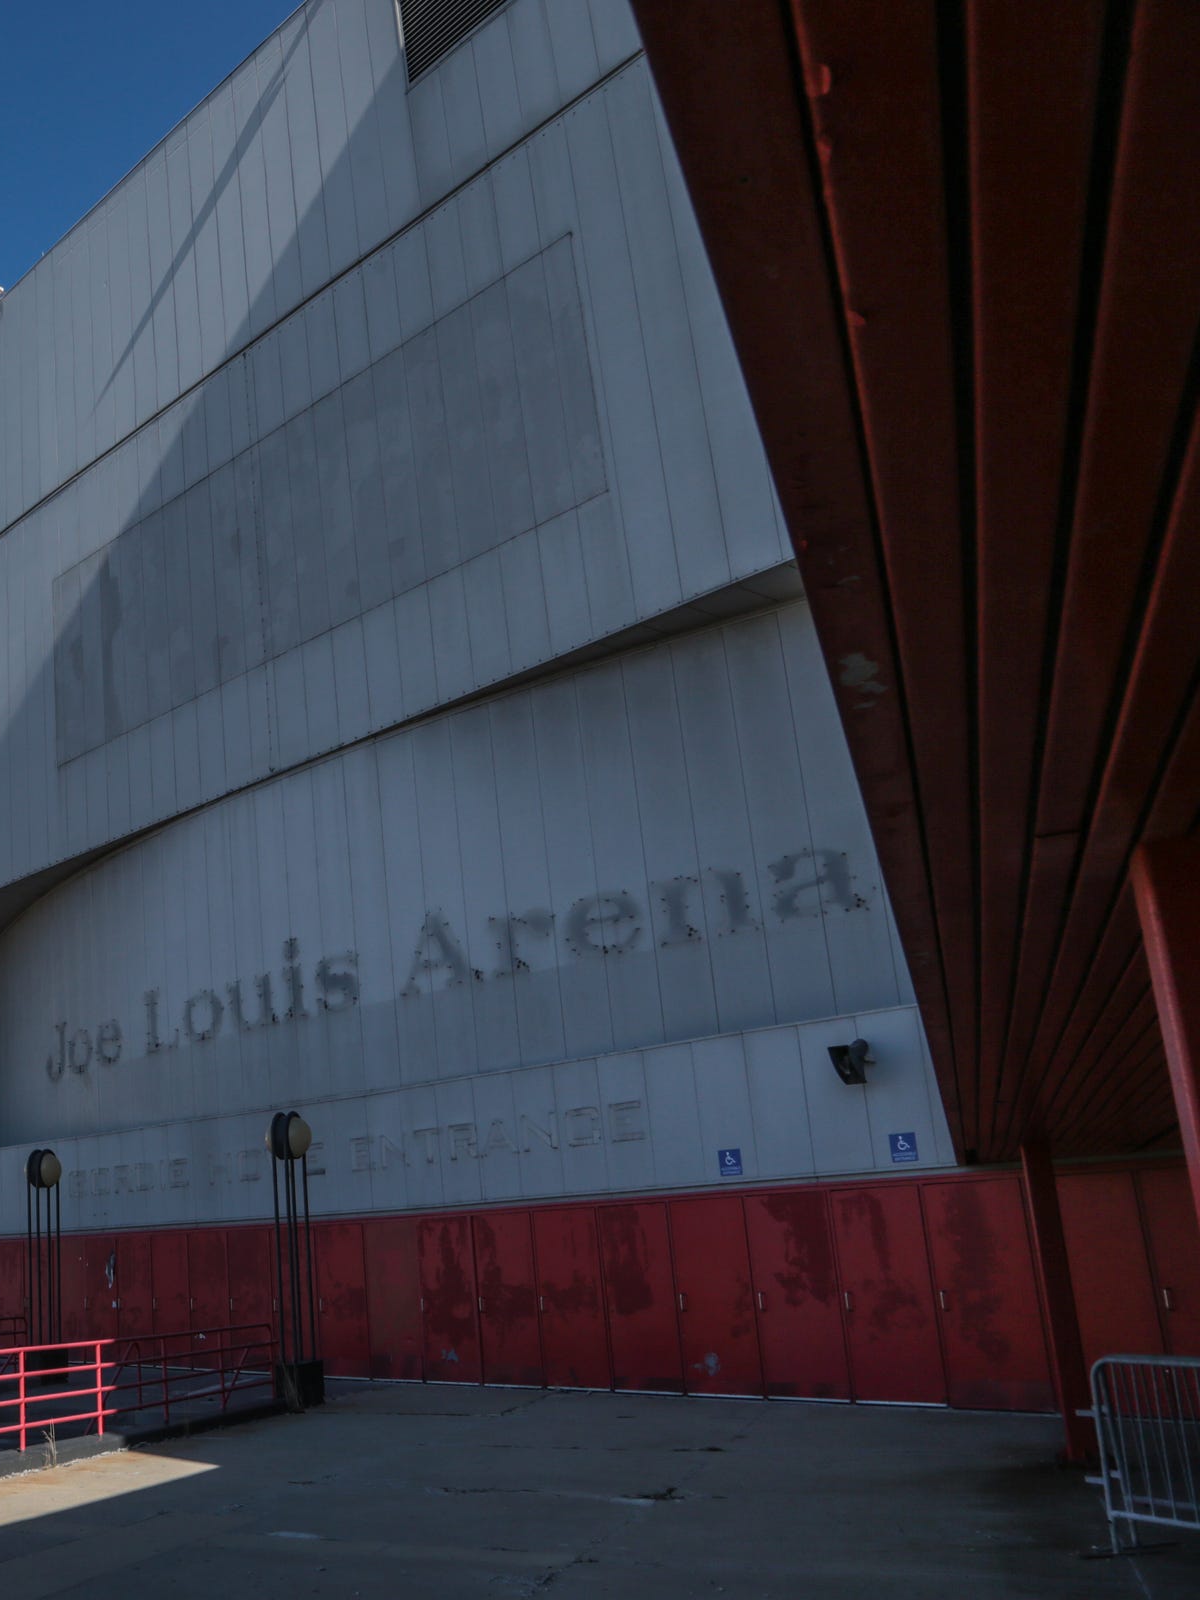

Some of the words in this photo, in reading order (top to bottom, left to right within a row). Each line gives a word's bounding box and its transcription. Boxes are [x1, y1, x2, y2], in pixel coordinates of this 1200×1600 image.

[45, 1018, 123, 1084] Joe
[144, 937, 360, 1055] Louis
[400, 847, 873, 997] Arena
[207, 1141, 326, 1187] HOE
[349, 1099, 648, 1173] ENTRANCE
